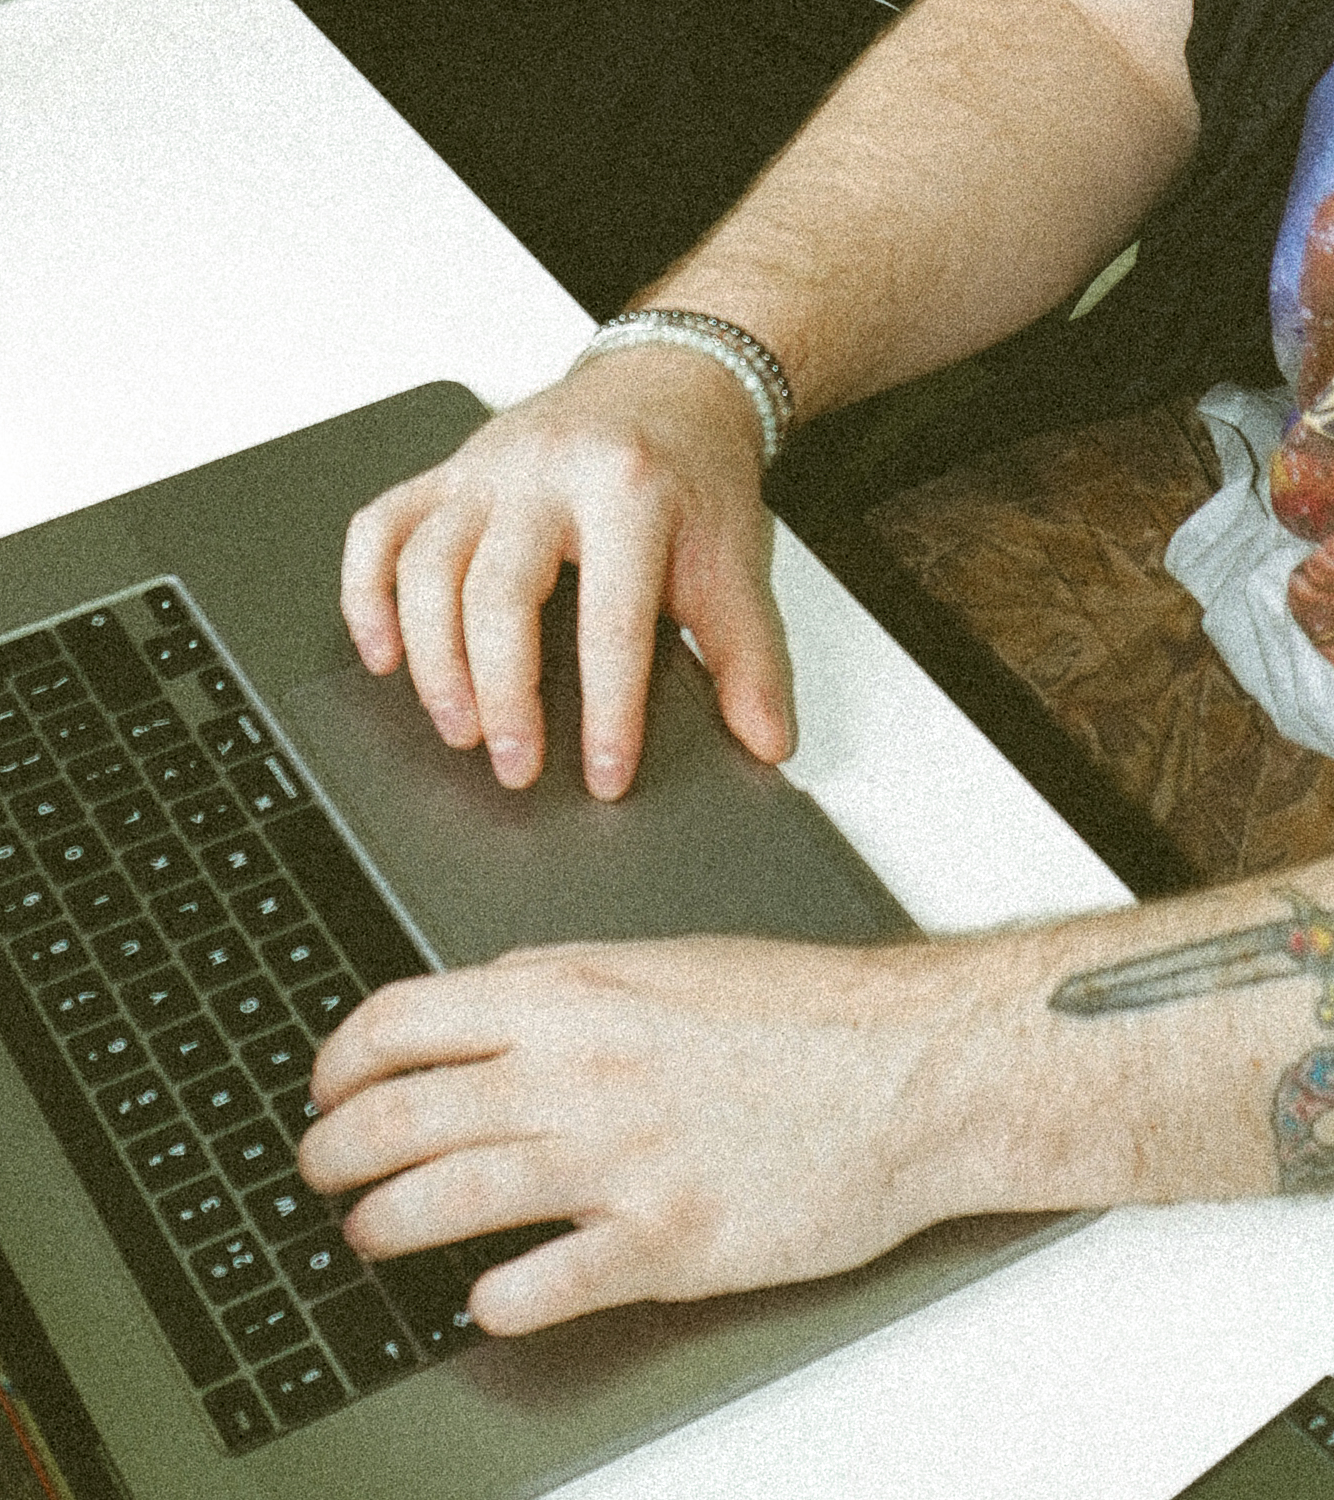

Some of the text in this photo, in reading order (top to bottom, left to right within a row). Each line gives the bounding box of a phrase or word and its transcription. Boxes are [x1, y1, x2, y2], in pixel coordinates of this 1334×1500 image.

[37, 802, 56, 816] P
[150, 855, 169, 871] K
[228, 851, 248, 869] M
[259, 897, 278, 915] N
[121, 940, 141, 957] U
[208, 948, 228, 966] H
[290, 946, 310, 962] B
[239, 997, 260, 1014] G
[179, 1041, 199, 1056] T
[211, 1090, 231, 1108] R
[242, 1144, 264, 1161] E
[274, 1195, 297, 1217] W
